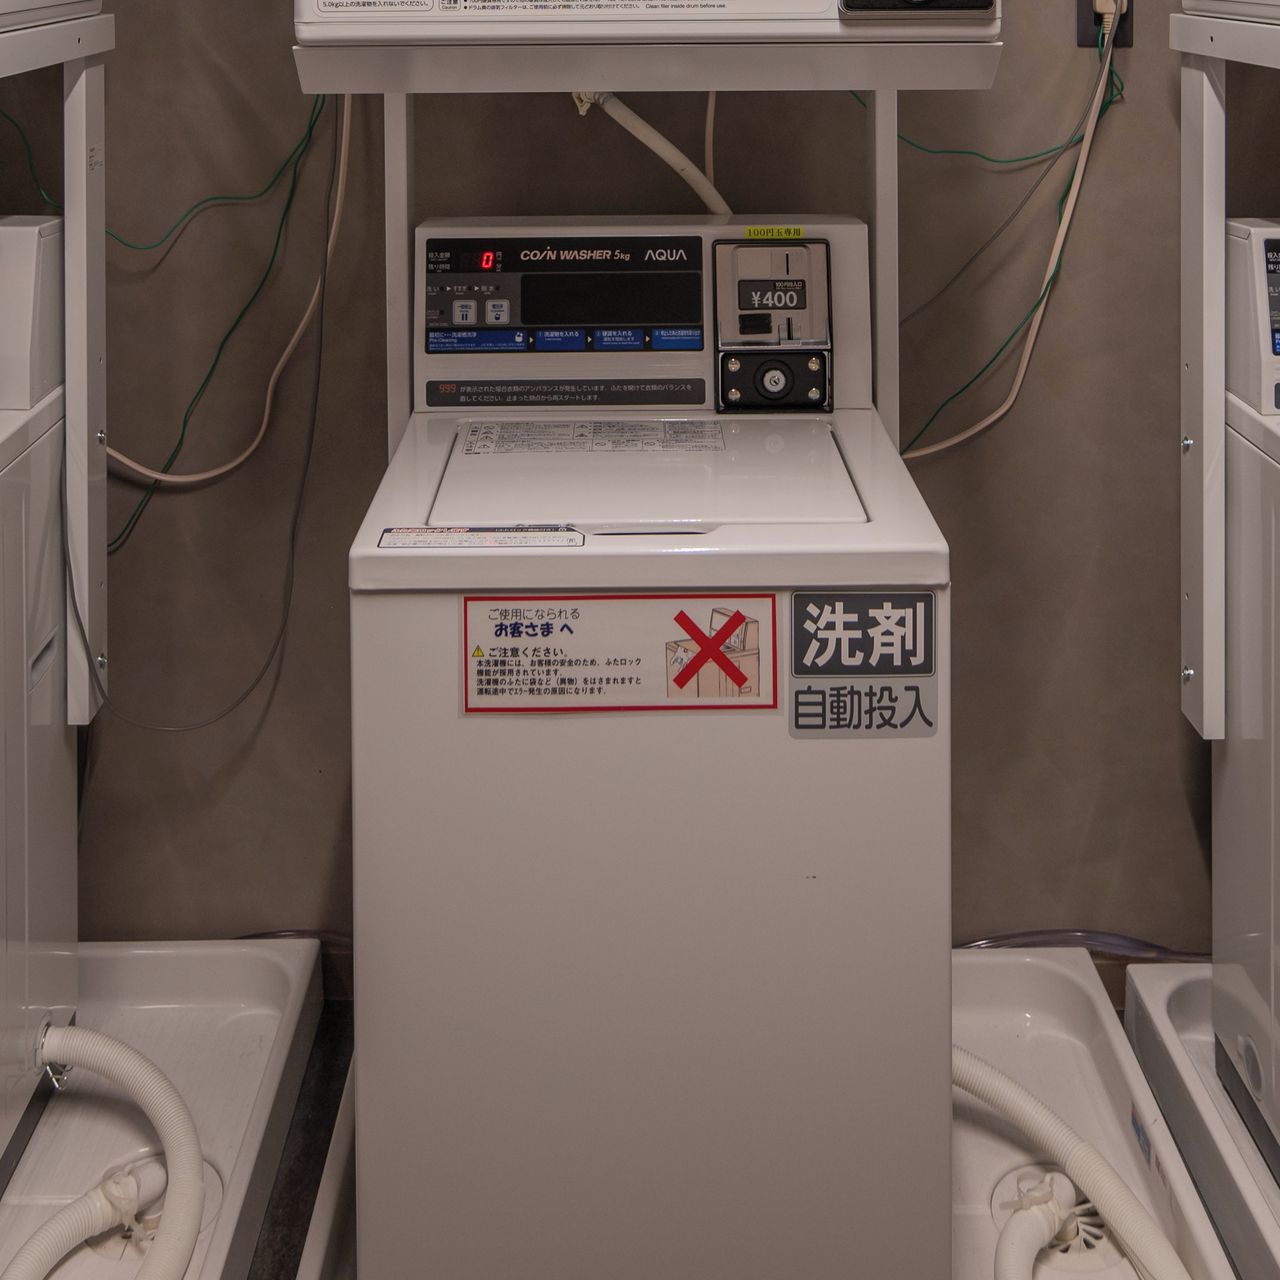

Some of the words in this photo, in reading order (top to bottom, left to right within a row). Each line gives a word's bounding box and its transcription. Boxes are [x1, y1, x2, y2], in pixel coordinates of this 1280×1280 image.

[749, 226, 800, 236] 100円玉専用
[480, 251, 494, 269] 0
[521, 246, 556, 260] COIN
[560, 250, 611, 259] WASHER
[614, 250, 630, 261] 5kg
[645, 250, 687, 260] AQUA
[752, 290, 797, 308] ¥400
[489, 608, 579, 622] ご使用になられる
[802, 600, 927, 670] 洗剤
[489, 647, 569, 657] ご注意ください。
[795, 685, 933, 729] 自動投入
